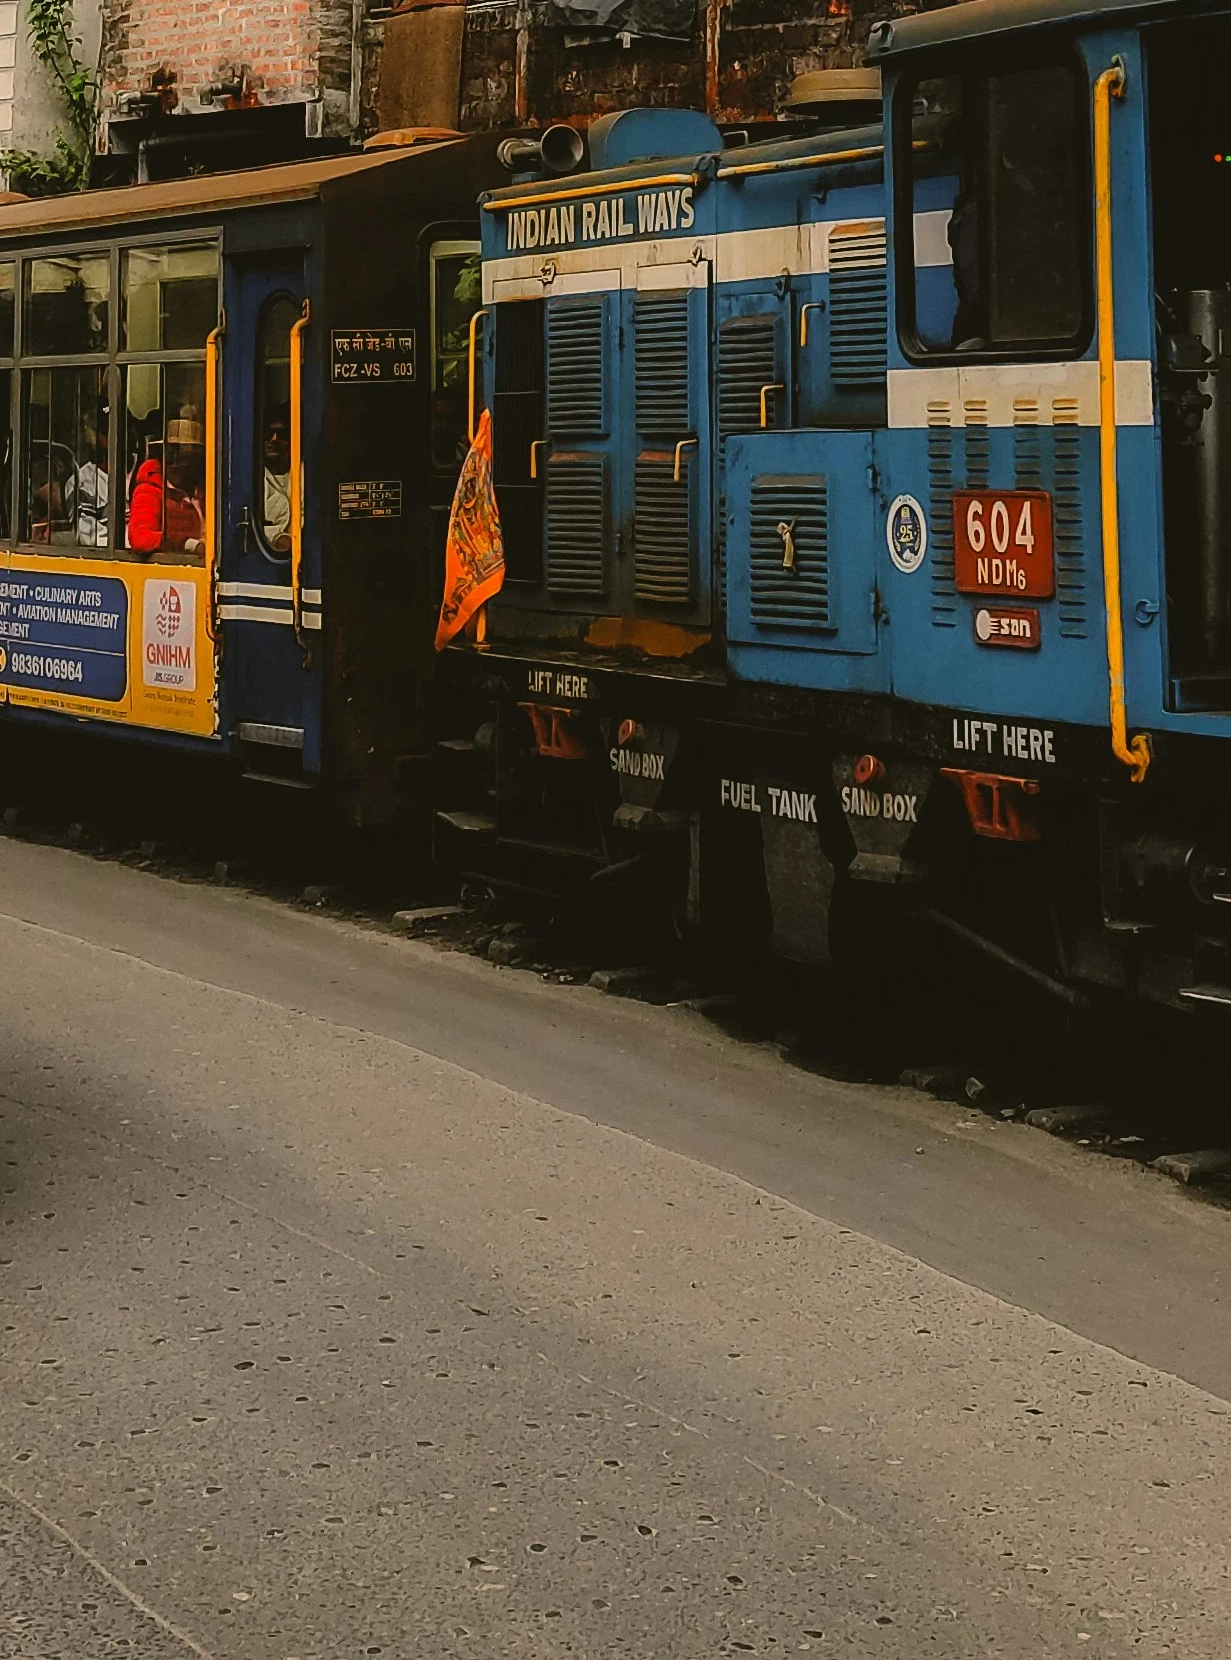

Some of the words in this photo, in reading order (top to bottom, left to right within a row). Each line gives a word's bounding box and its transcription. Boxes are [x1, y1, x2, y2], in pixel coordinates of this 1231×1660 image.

[507, 205, 575, 251] INDIAN
[394, 362, 413, 376] 603
[967, 500, 1035, 554] 604
[35, 586, 77, 605] CULINARY
[79, 590, 102, 607] ARTS
[17, 604, 56, 623] AVIATION
[57, 608, 120, 630] MANAGEMENT
[11, 652, 83, 682] 9836106964
[146, 643, 191, 670] GNIHM
[528, 670, 552, 694] LIFT
[556, 673, 588, 698] HERE
[953, 718, 997, 754] LIFT
[1003, 725, 1056, 763] HERE
[609, 747, 641, 777] SAND
[642, 753, 665, 781] BOX
[721, 778, 761, 813] FUEL
[768, 787, 818, 824] TANK
[841, 786, 880, 818] SAND
[883, 793, 918, 823] BOX
